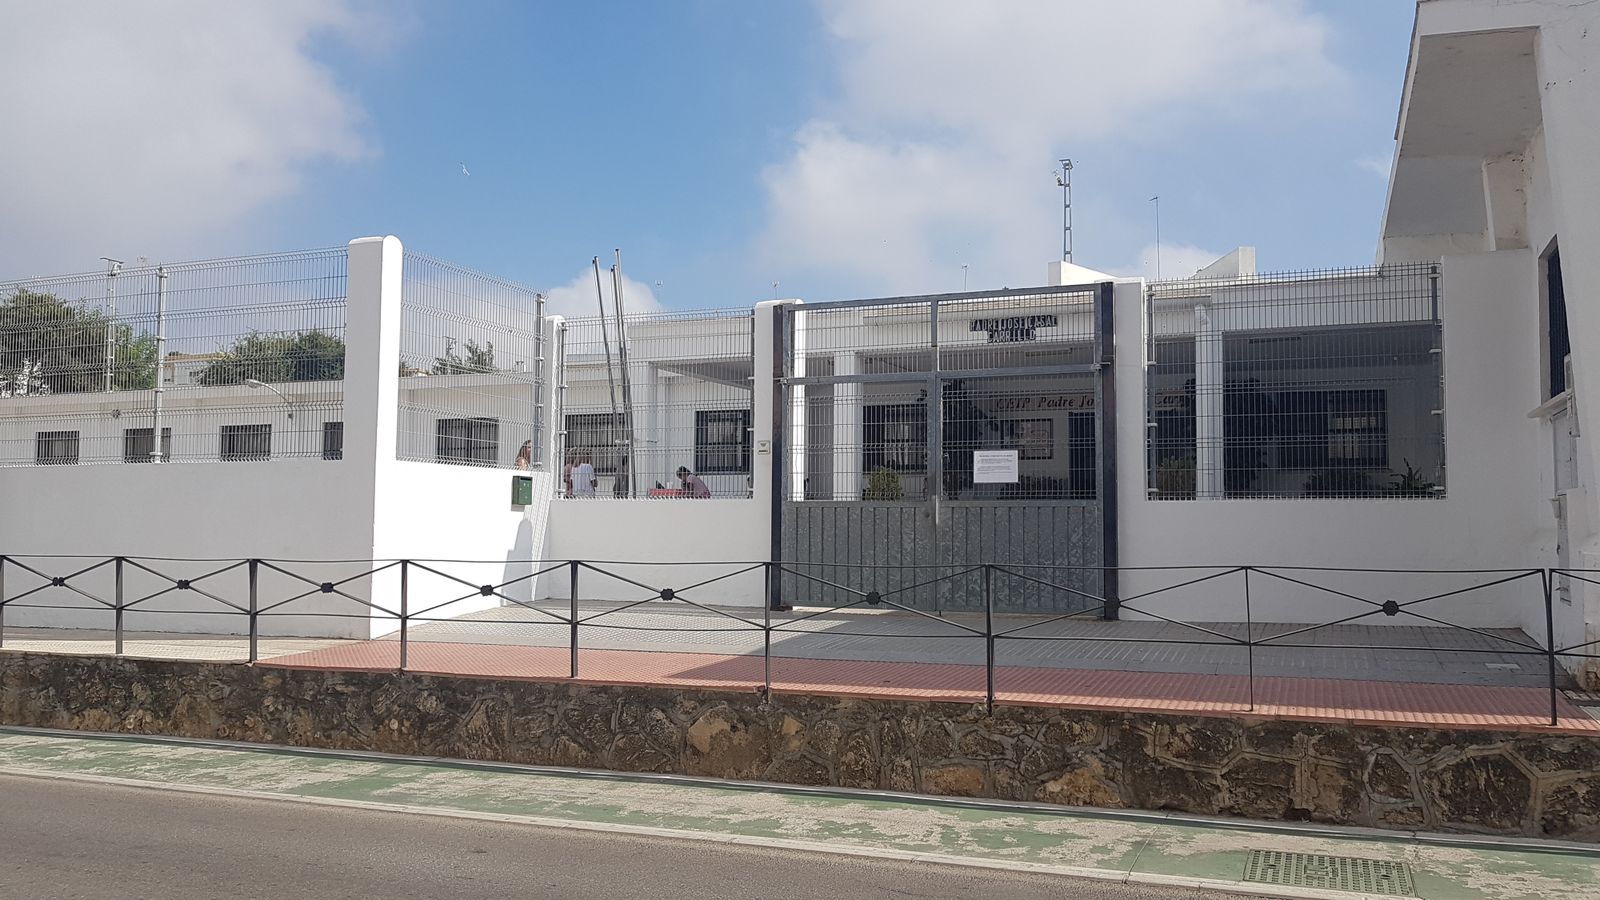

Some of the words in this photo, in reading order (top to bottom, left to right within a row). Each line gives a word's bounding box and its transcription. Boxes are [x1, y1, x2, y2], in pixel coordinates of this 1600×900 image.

[970, 319, 998, 331] PADRE
[987, 329, 1036, 343] CARRILLO
[1038, 395, 1075, 408] Padre
